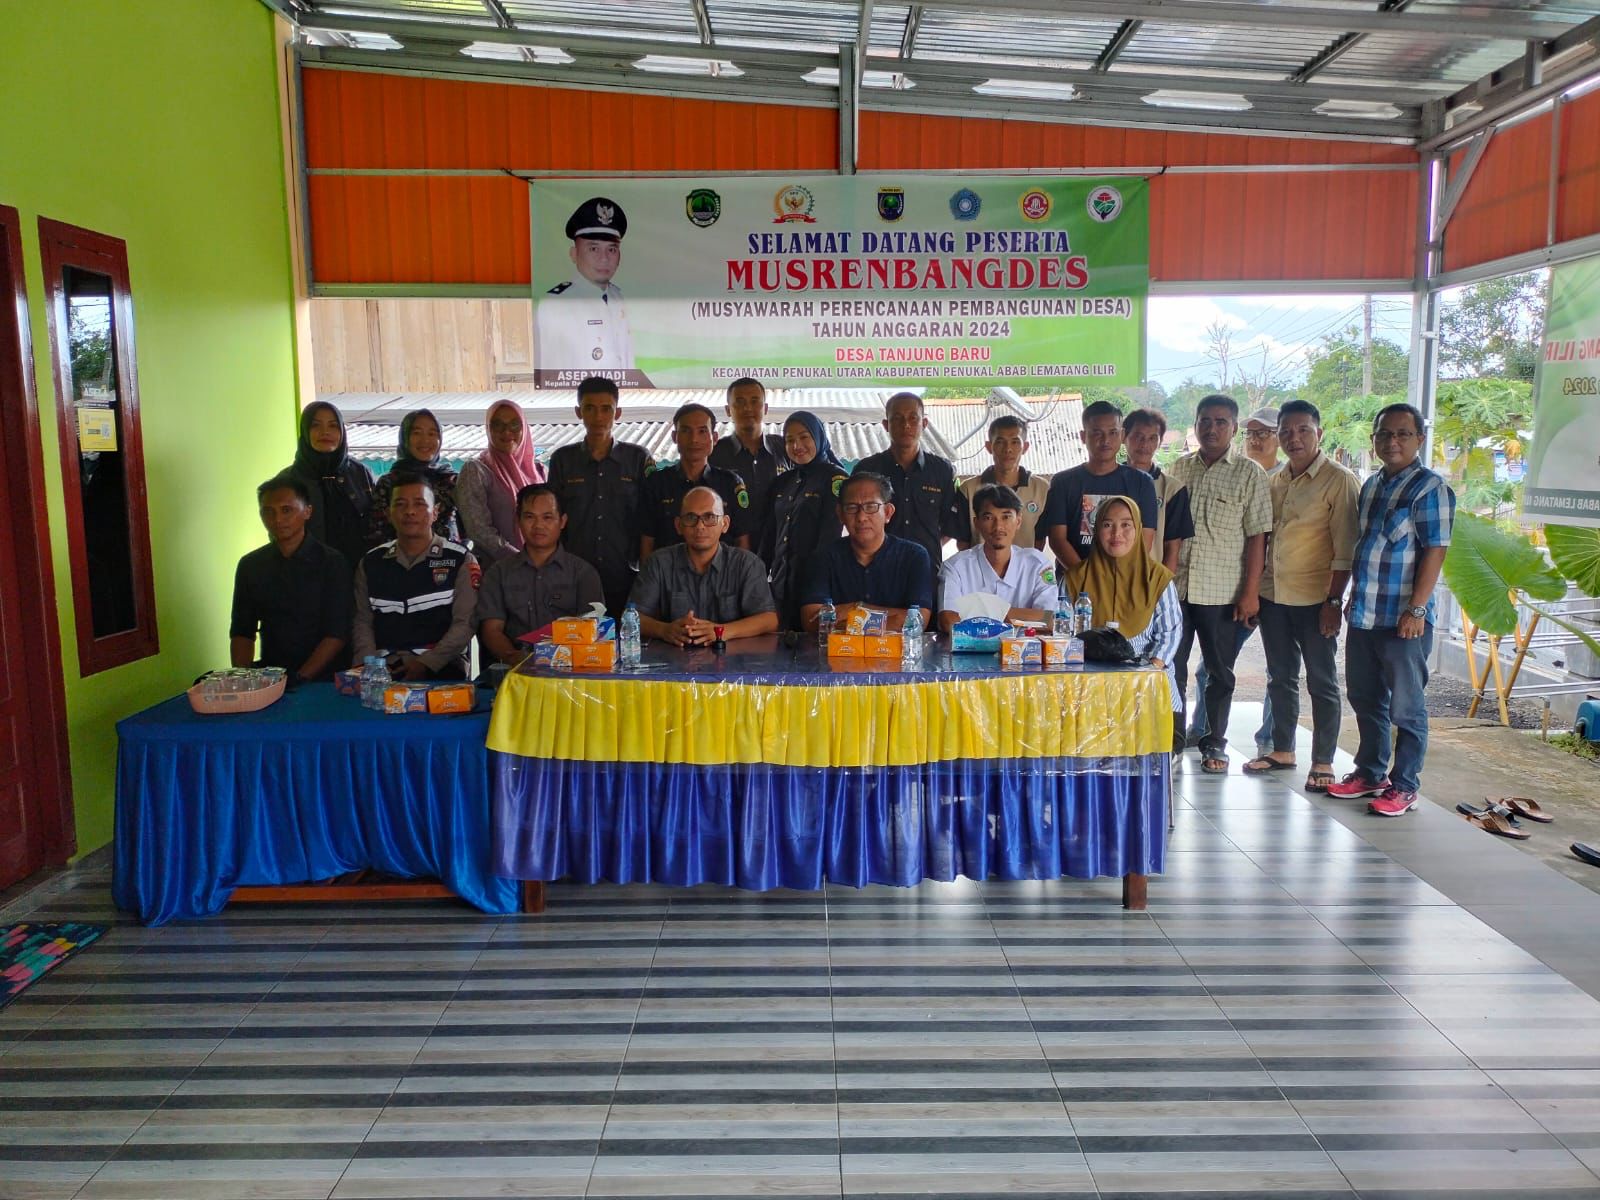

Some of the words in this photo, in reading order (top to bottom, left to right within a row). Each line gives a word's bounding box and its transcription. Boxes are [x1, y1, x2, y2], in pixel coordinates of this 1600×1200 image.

[749, 232, 851, 254] SELAMAT
[862, 231, 954, 253] DATANG
[966, 231, 1069, 253] PESERTA
[726, 258, 1089, 291] MUSRENBANGDES
[691, 301, 814, 320] (MUSYAWARAH
[820, 300, 942, 317] PERENCANAAN
[950, 299, 1076, 316] PEMBANGUNAN
[1082, 298, 1132, 318] DESA)
[812, 322, 866, 338] TAHUN
[872, 321, 963, 338] ANGGARAN
[969, 321, 1010, 337] 2024
[836, 348, 874, 361] DESA
[879, 348, 945, 361] TANJUNG
[950, 347, 991, 360] BARU
[557, 371, 588, 381] ASEP
[712, 367, 779, 379] KECAMATAN
[782, 367, 833, 378] PENUKAL
[836, 367, 872, 378] UTARA
[875, 366, 939, 377] KABUPATEN
[943, 366, 994, 377] PENUKAL
[997, 366, 1027, 377] ABAB
[1031, 365, 1089, 376] LEMATANG
[1093, 364, 1115, 376] ILIR
